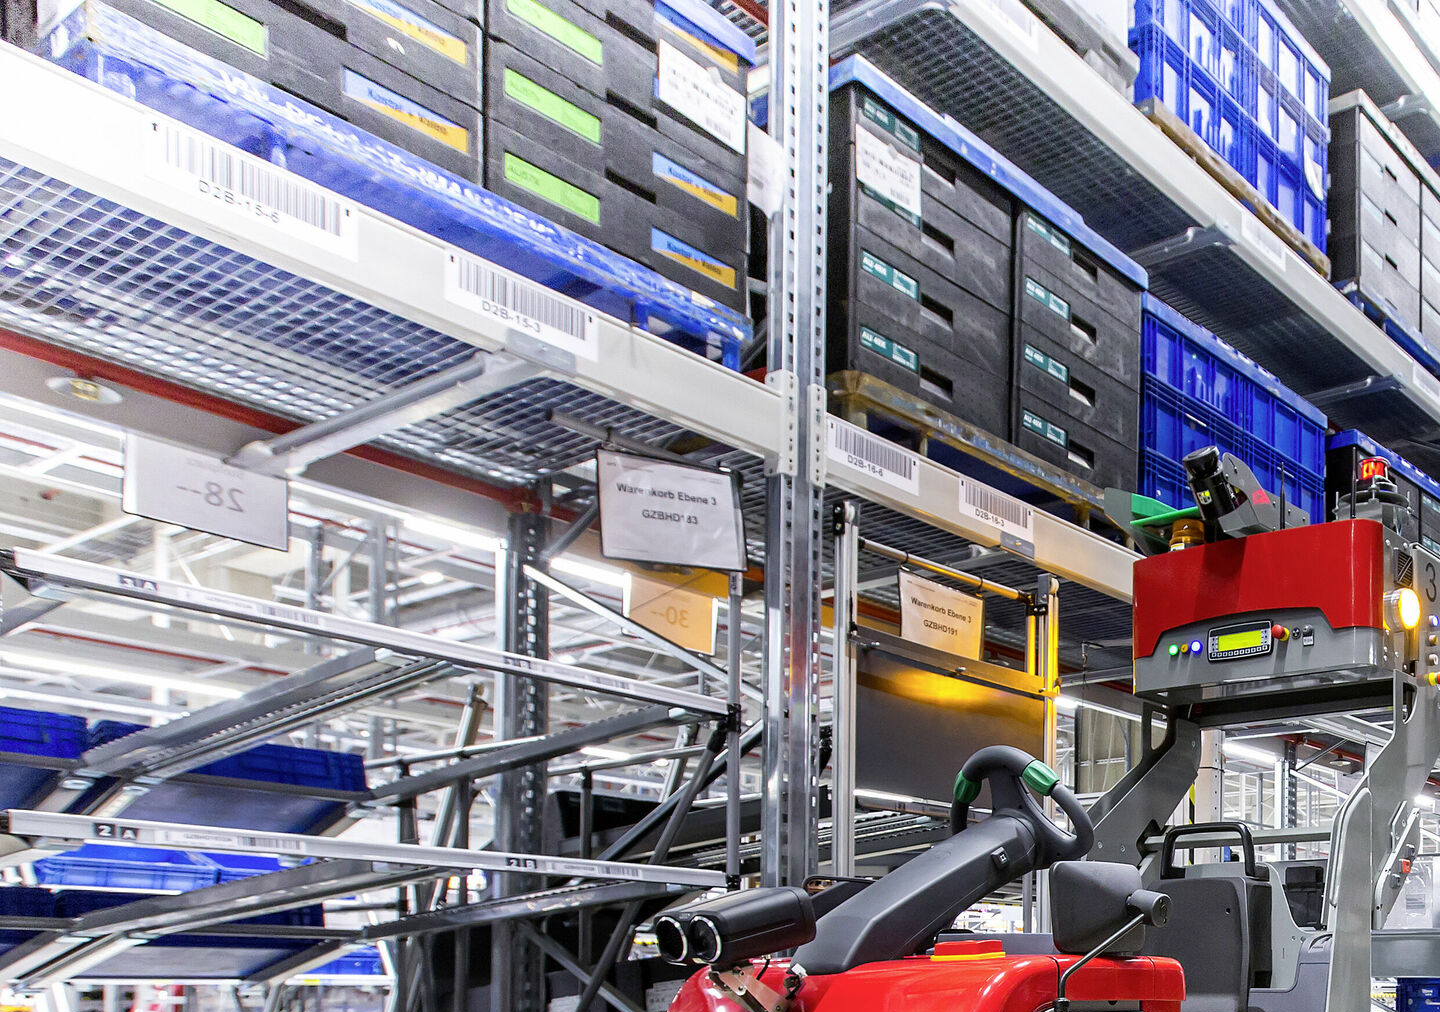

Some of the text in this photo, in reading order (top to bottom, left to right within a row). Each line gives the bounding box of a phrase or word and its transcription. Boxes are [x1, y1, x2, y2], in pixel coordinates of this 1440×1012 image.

[198, 179, 281, 224] D2B-15-6
[481, 300, 541, 334] D2B-15-3
[847, 454, 884, 478] D2B-16-6
[616, 483, 718, 506] Warekorb Ebene 3
[974, 508, 1006, 528] D2B-16-3
[1425, 562, 1437, 603] 3
[910, 596, 972, 624] Warenkorb Ebene 3
[923, 619, 958, 636] GZBHD191
[98, 824, 137, 840] 2 A
